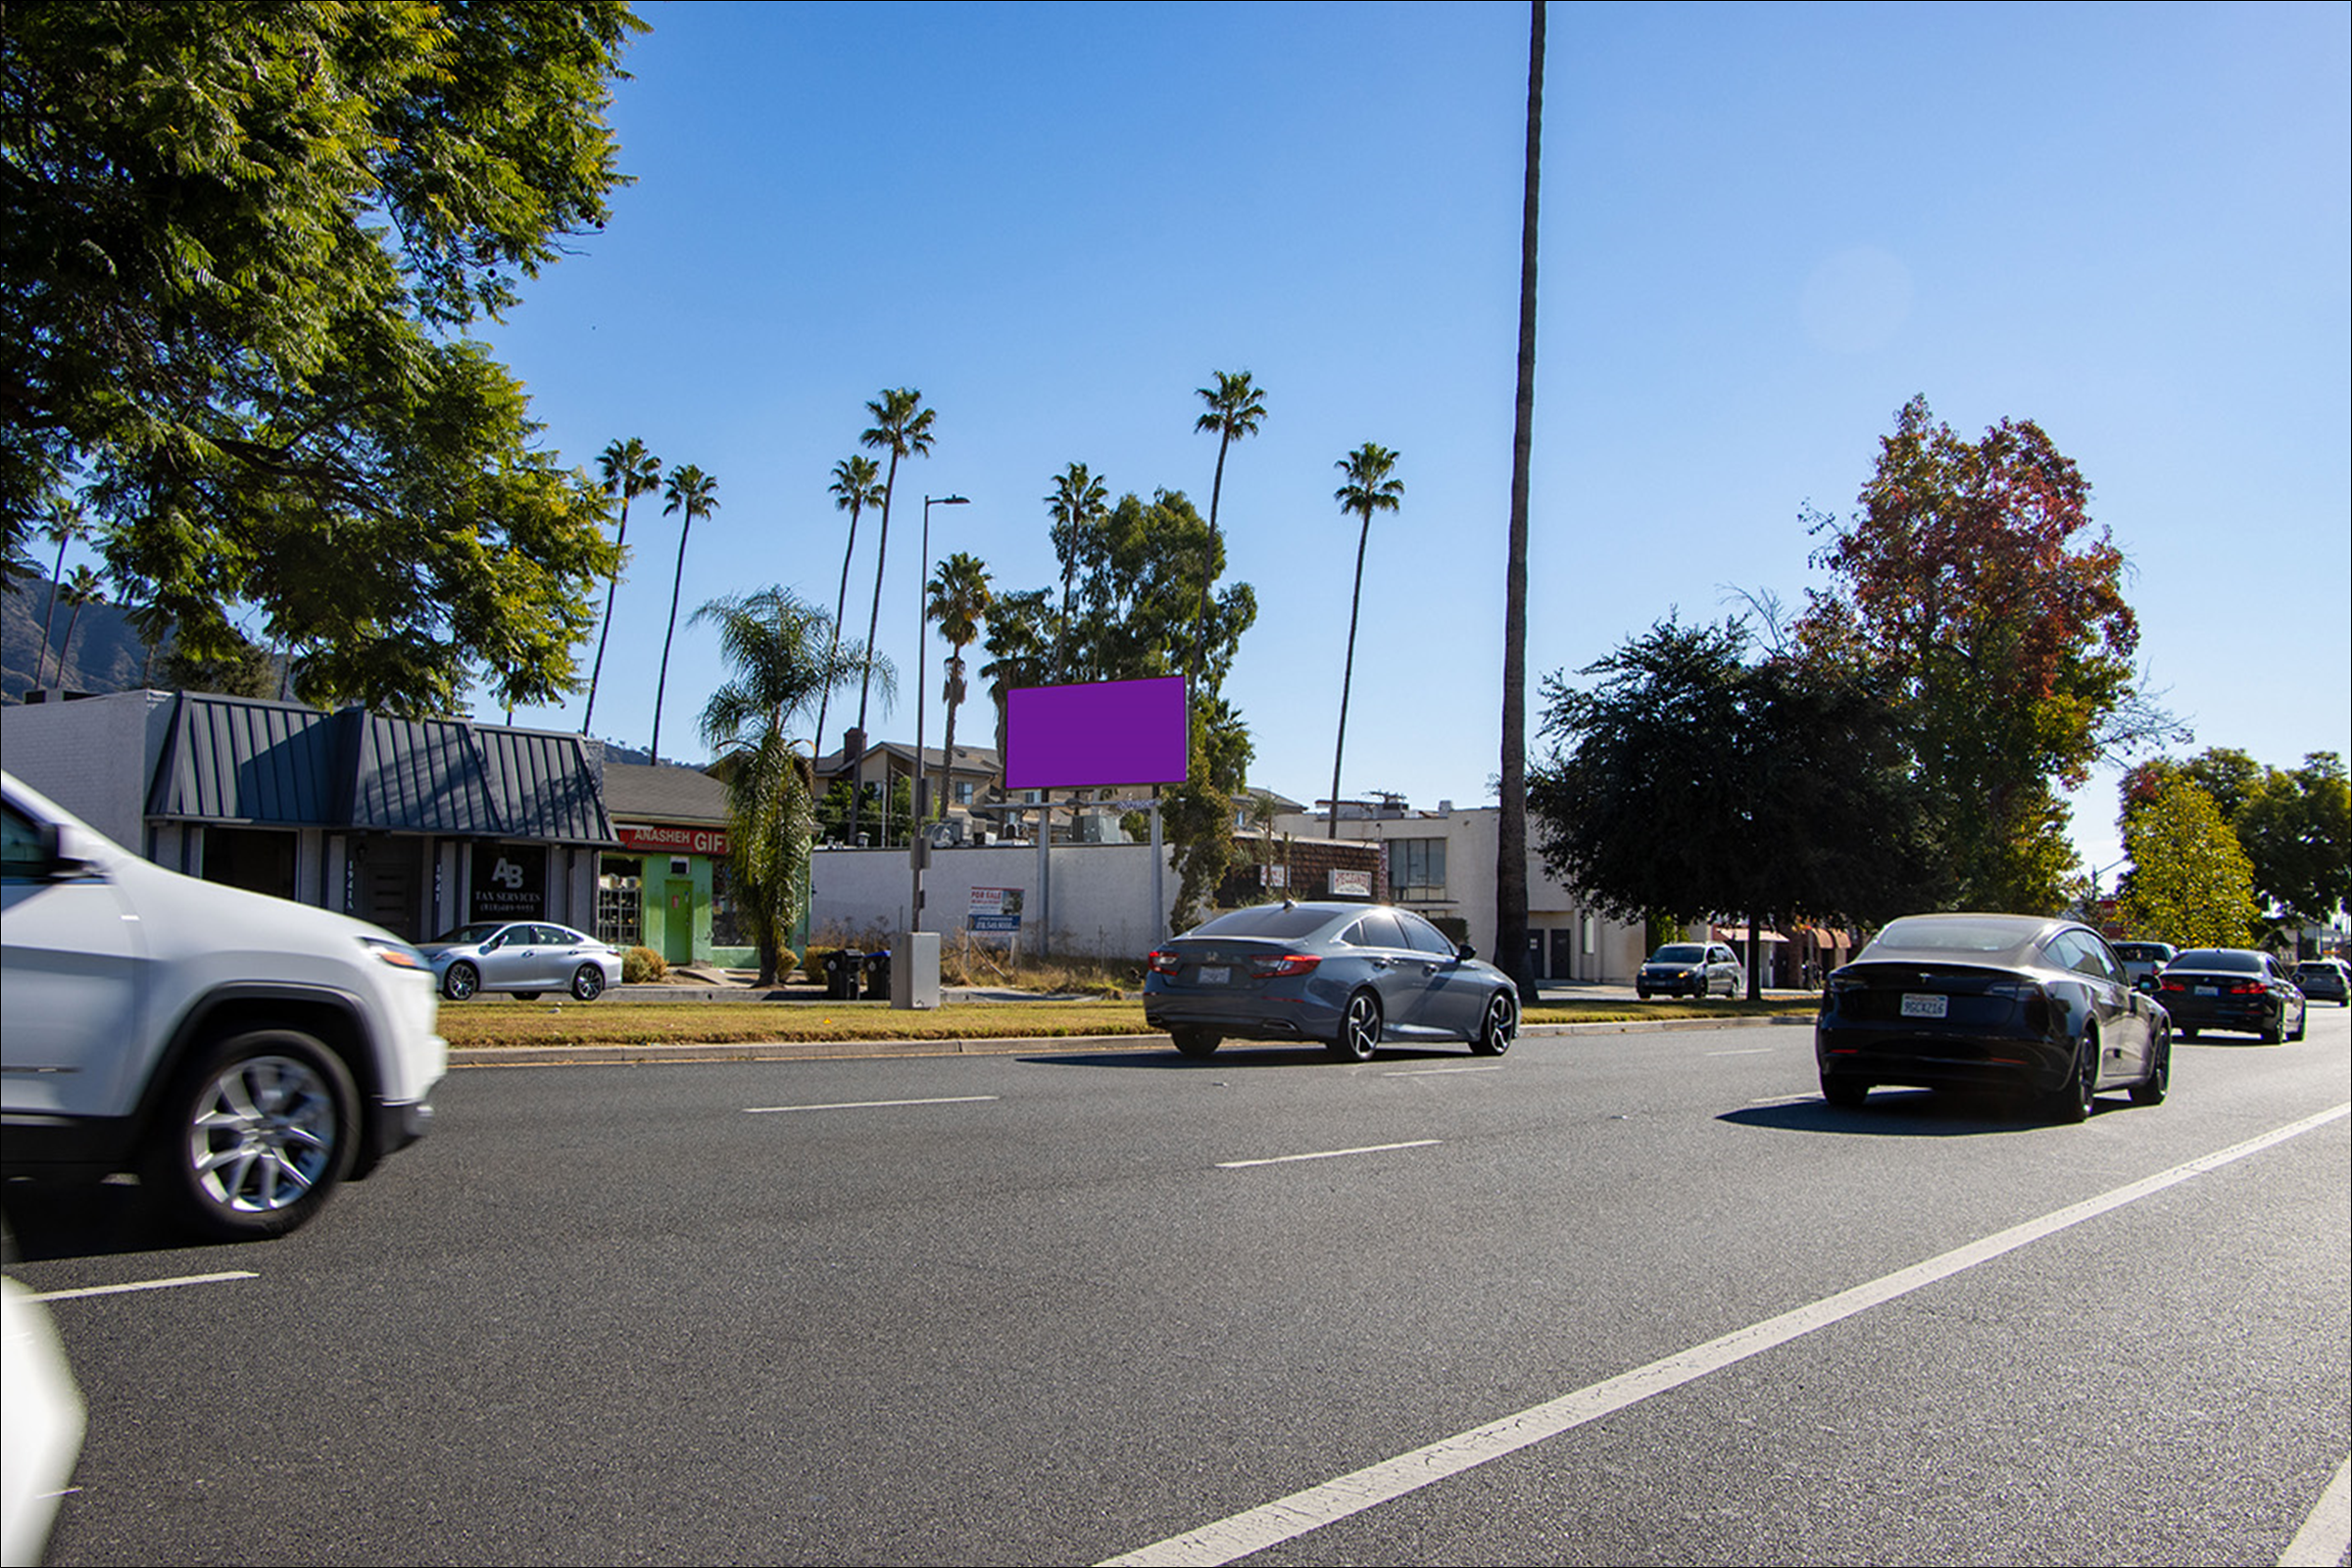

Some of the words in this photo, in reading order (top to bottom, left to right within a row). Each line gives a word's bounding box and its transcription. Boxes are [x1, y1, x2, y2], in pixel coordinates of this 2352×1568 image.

[491, 858, 524, 889] AB
[475, 891, 495, 901] TAX
[496, 892, 541, 902] SERVICES
[986, 891, 1002, 900] SALE
